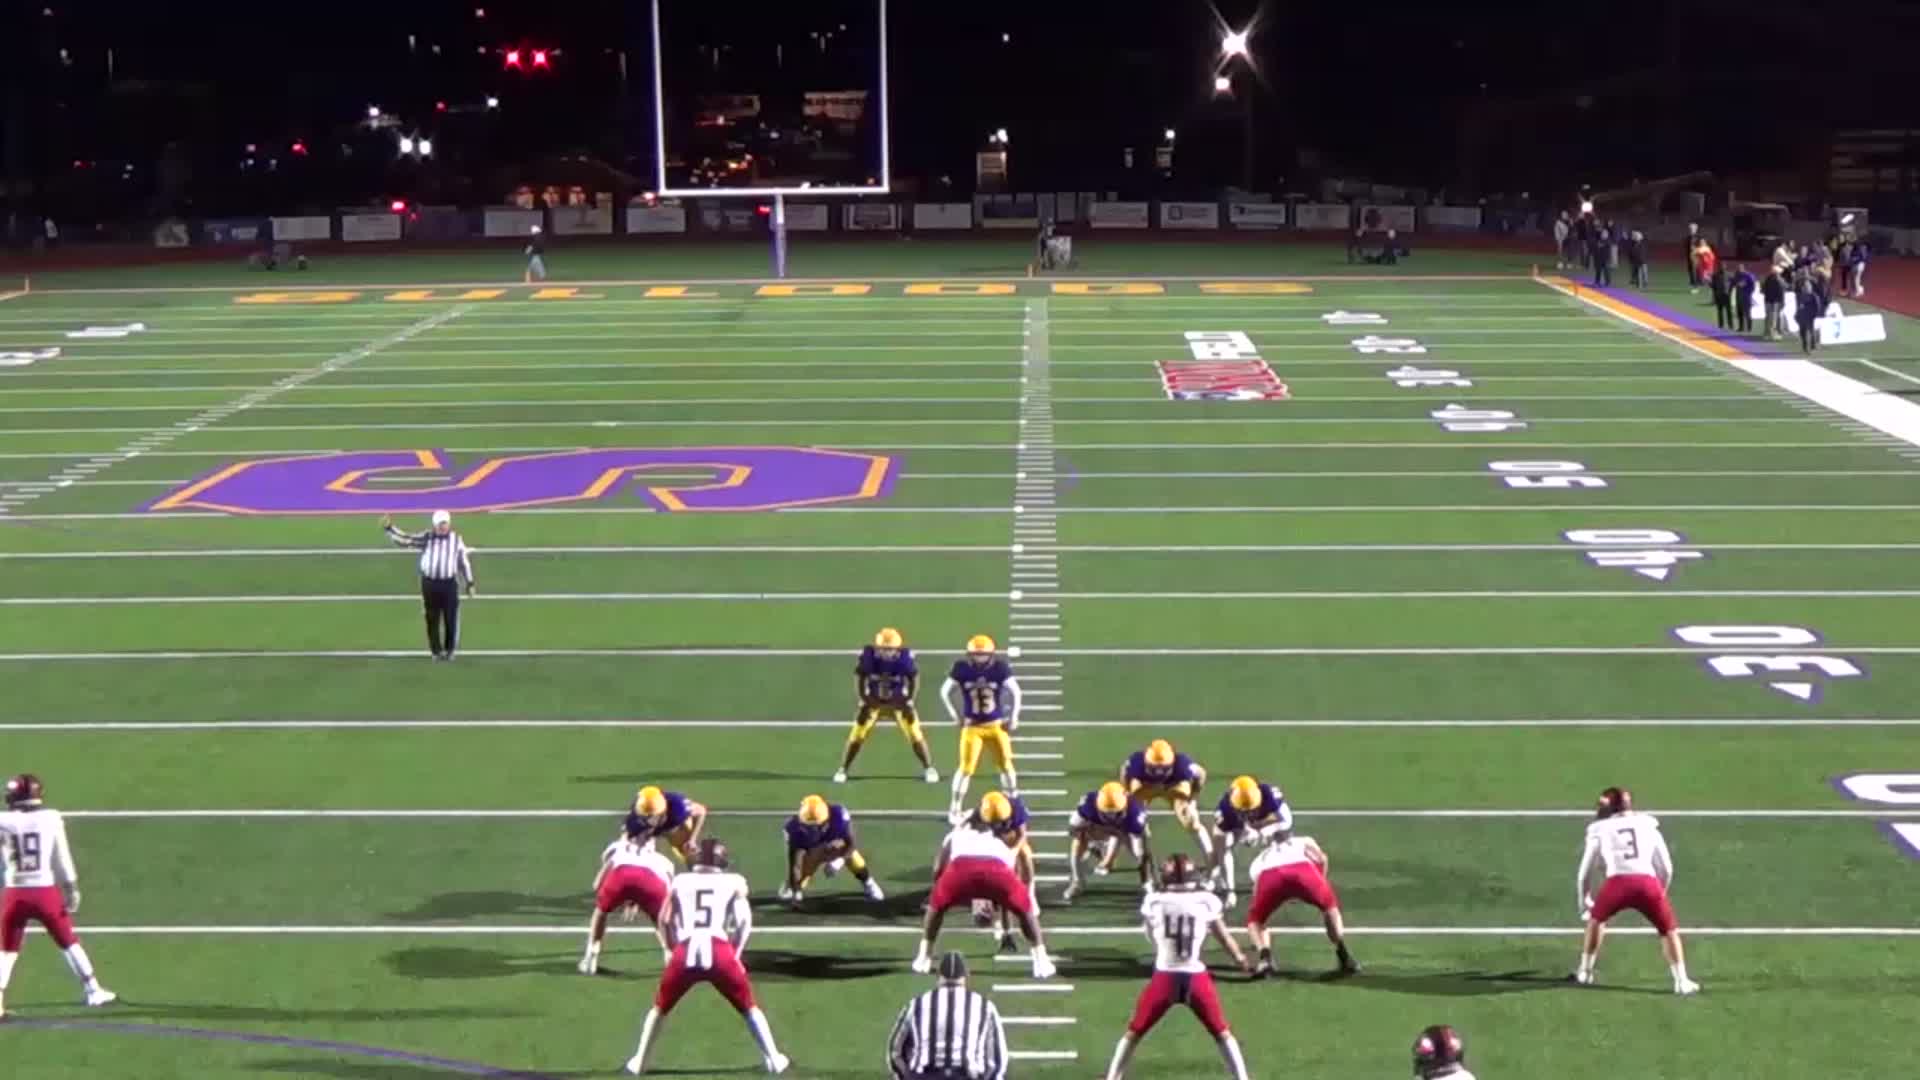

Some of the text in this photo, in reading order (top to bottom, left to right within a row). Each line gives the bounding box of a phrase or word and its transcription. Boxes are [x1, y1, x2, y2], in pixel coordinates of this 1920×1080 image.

[148, 445, 900, 514] S
[1487, 460, 1608, 488] 50
[1564, 529, 1704, 566] 40
[1674, 624, 1862, 677] 30
[970, 687, 997, 715] 13
[1616, 827, 1639, 860] 3
[693, 888, 715, 929] 5
